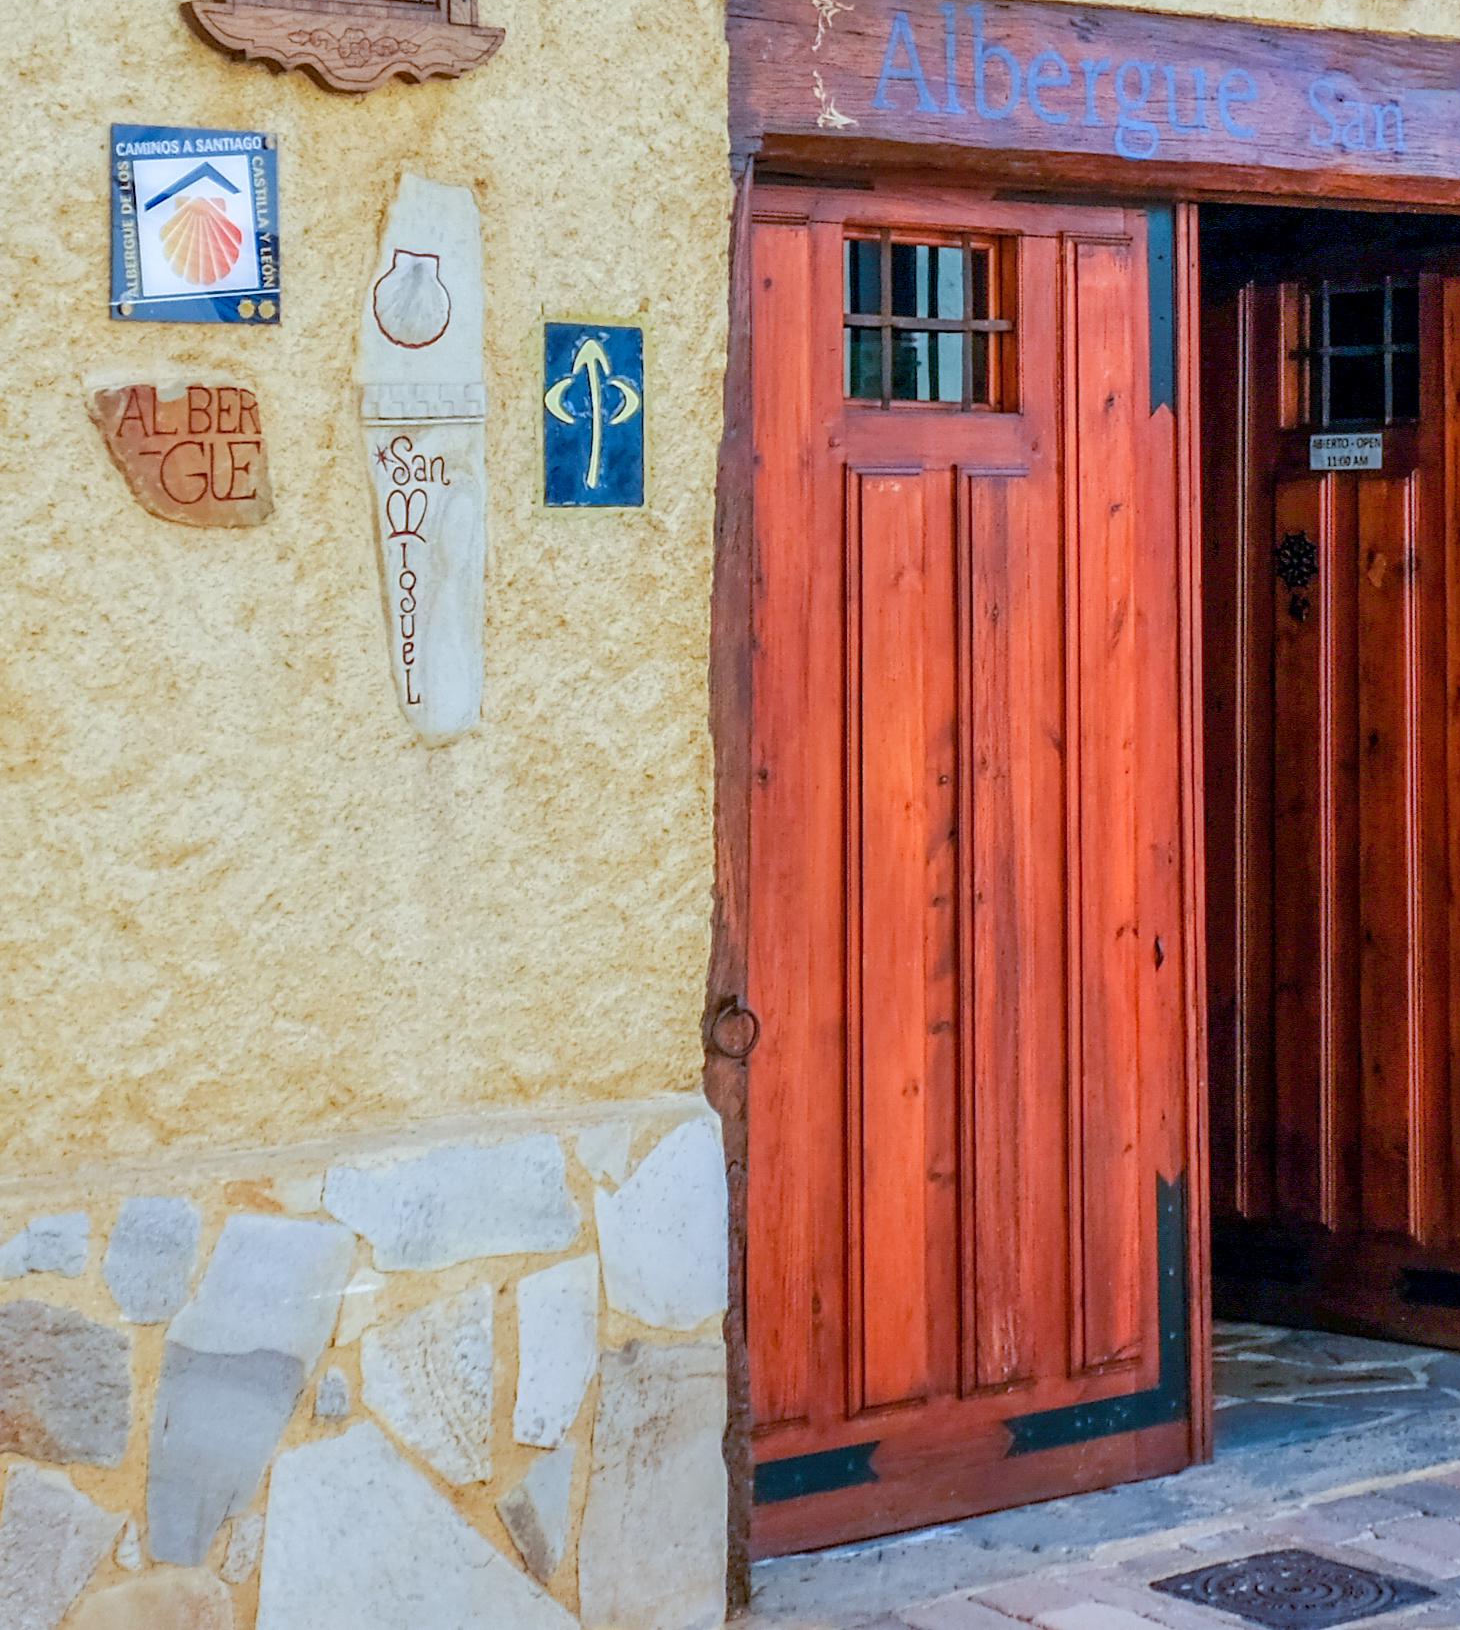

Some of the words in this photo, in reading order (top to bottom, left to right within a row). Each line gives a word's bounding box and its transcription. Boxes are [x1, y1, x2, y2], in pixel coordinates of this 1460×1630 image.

[872, 2, 1260, 160] Albergue
[1309, 75, 1407, 153] San
[115, 140, 180, 156] CAMINOS
[182, 139, 193, 154] A
[195, 136, 262, 153] SANTIAGO
[117, 161, 133, 190] LOS
[251, 156, 271, 228] CASTILLA
[120, 195, 133, 215] DE
[122, 219, 140, 298] ALBERGUE
[259, 232, 271, 244] Y
[259, 248, 276, 289] LEÓN
[391, 436, 451, 486] San
